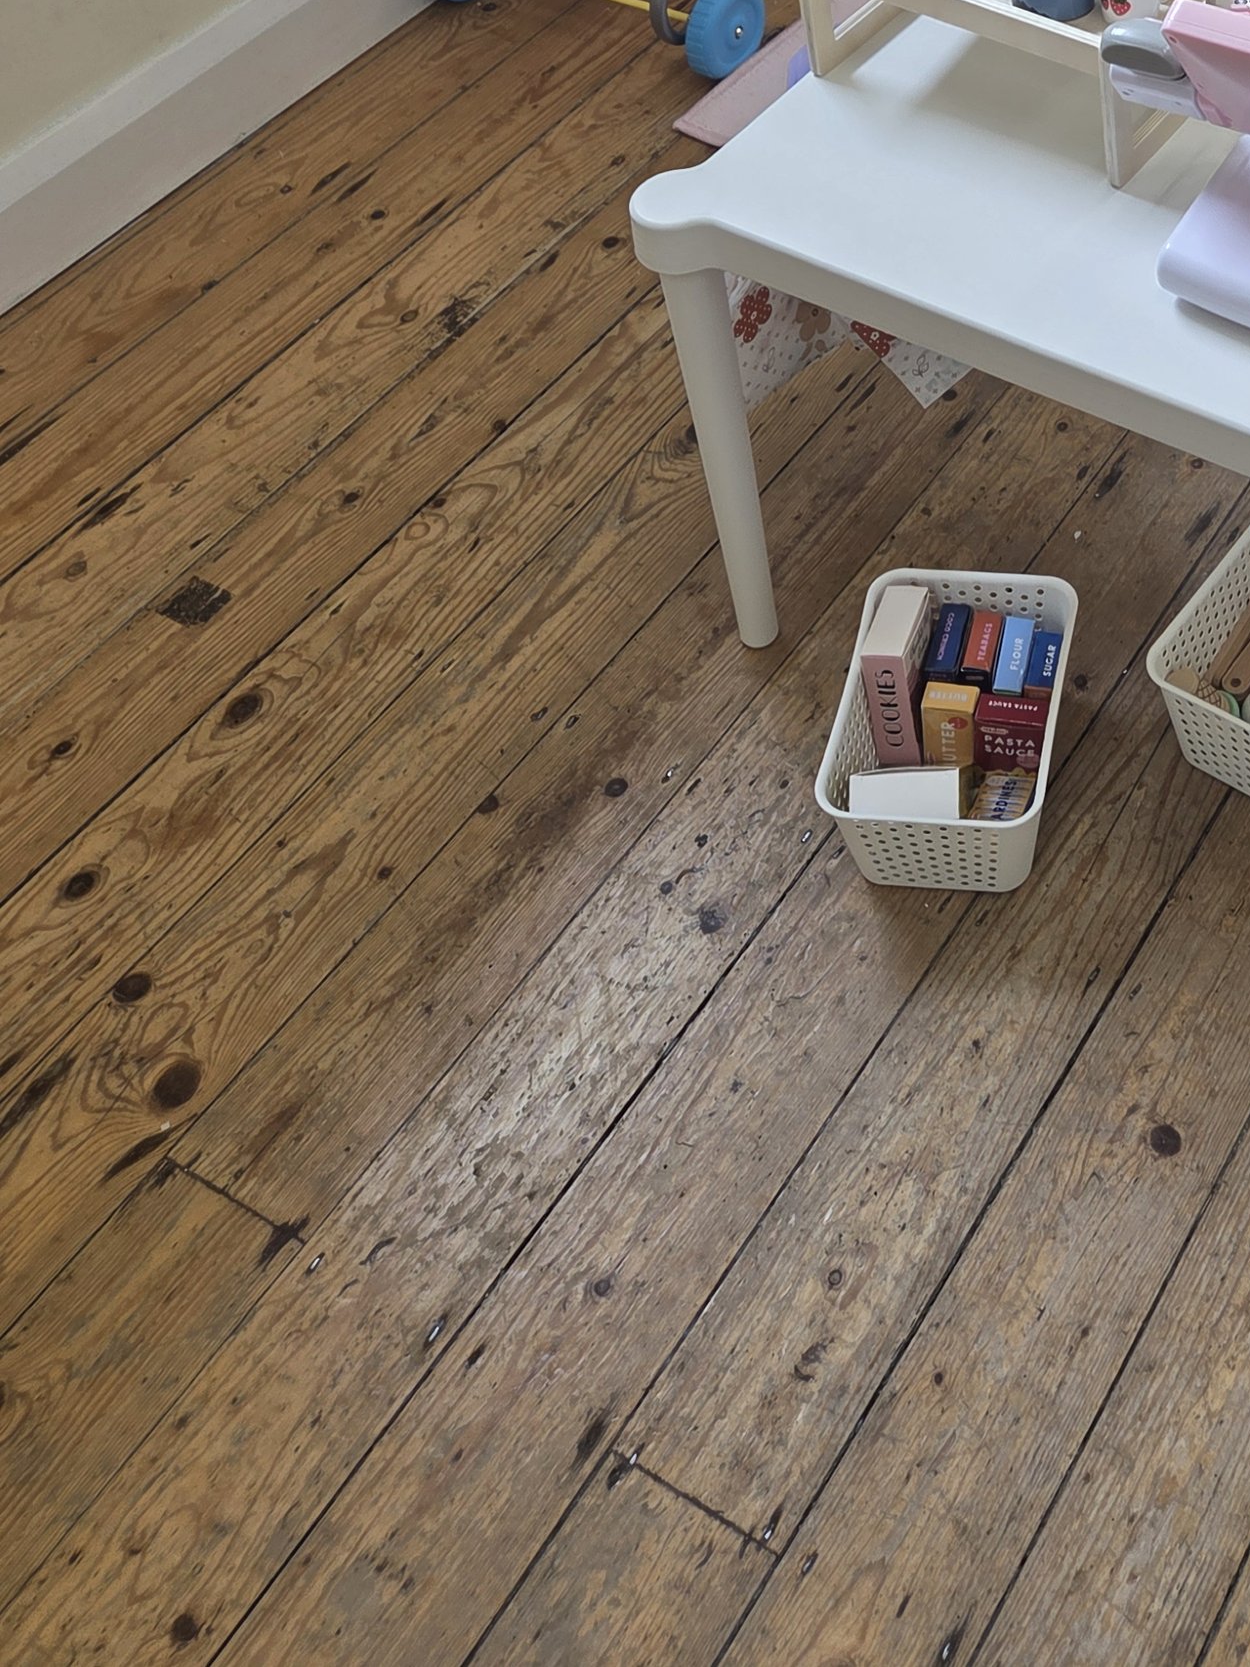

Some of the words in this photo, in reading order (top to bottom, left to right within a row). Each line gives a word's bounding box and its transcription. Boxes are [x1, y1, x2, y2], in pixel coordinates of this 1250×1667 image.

[976, 622, 993, 661] TEABAGS
[1010, 637, 1024, 671] FLOUR
[1042, 644, 1057, 677] SUGAR
[875, 669, 904, 747] COOKIES
[940, 721, 956, 767] UTTER
[983, 734, 1036, 748] PASTA
[984, 744, 1036, 757] SAUCE
